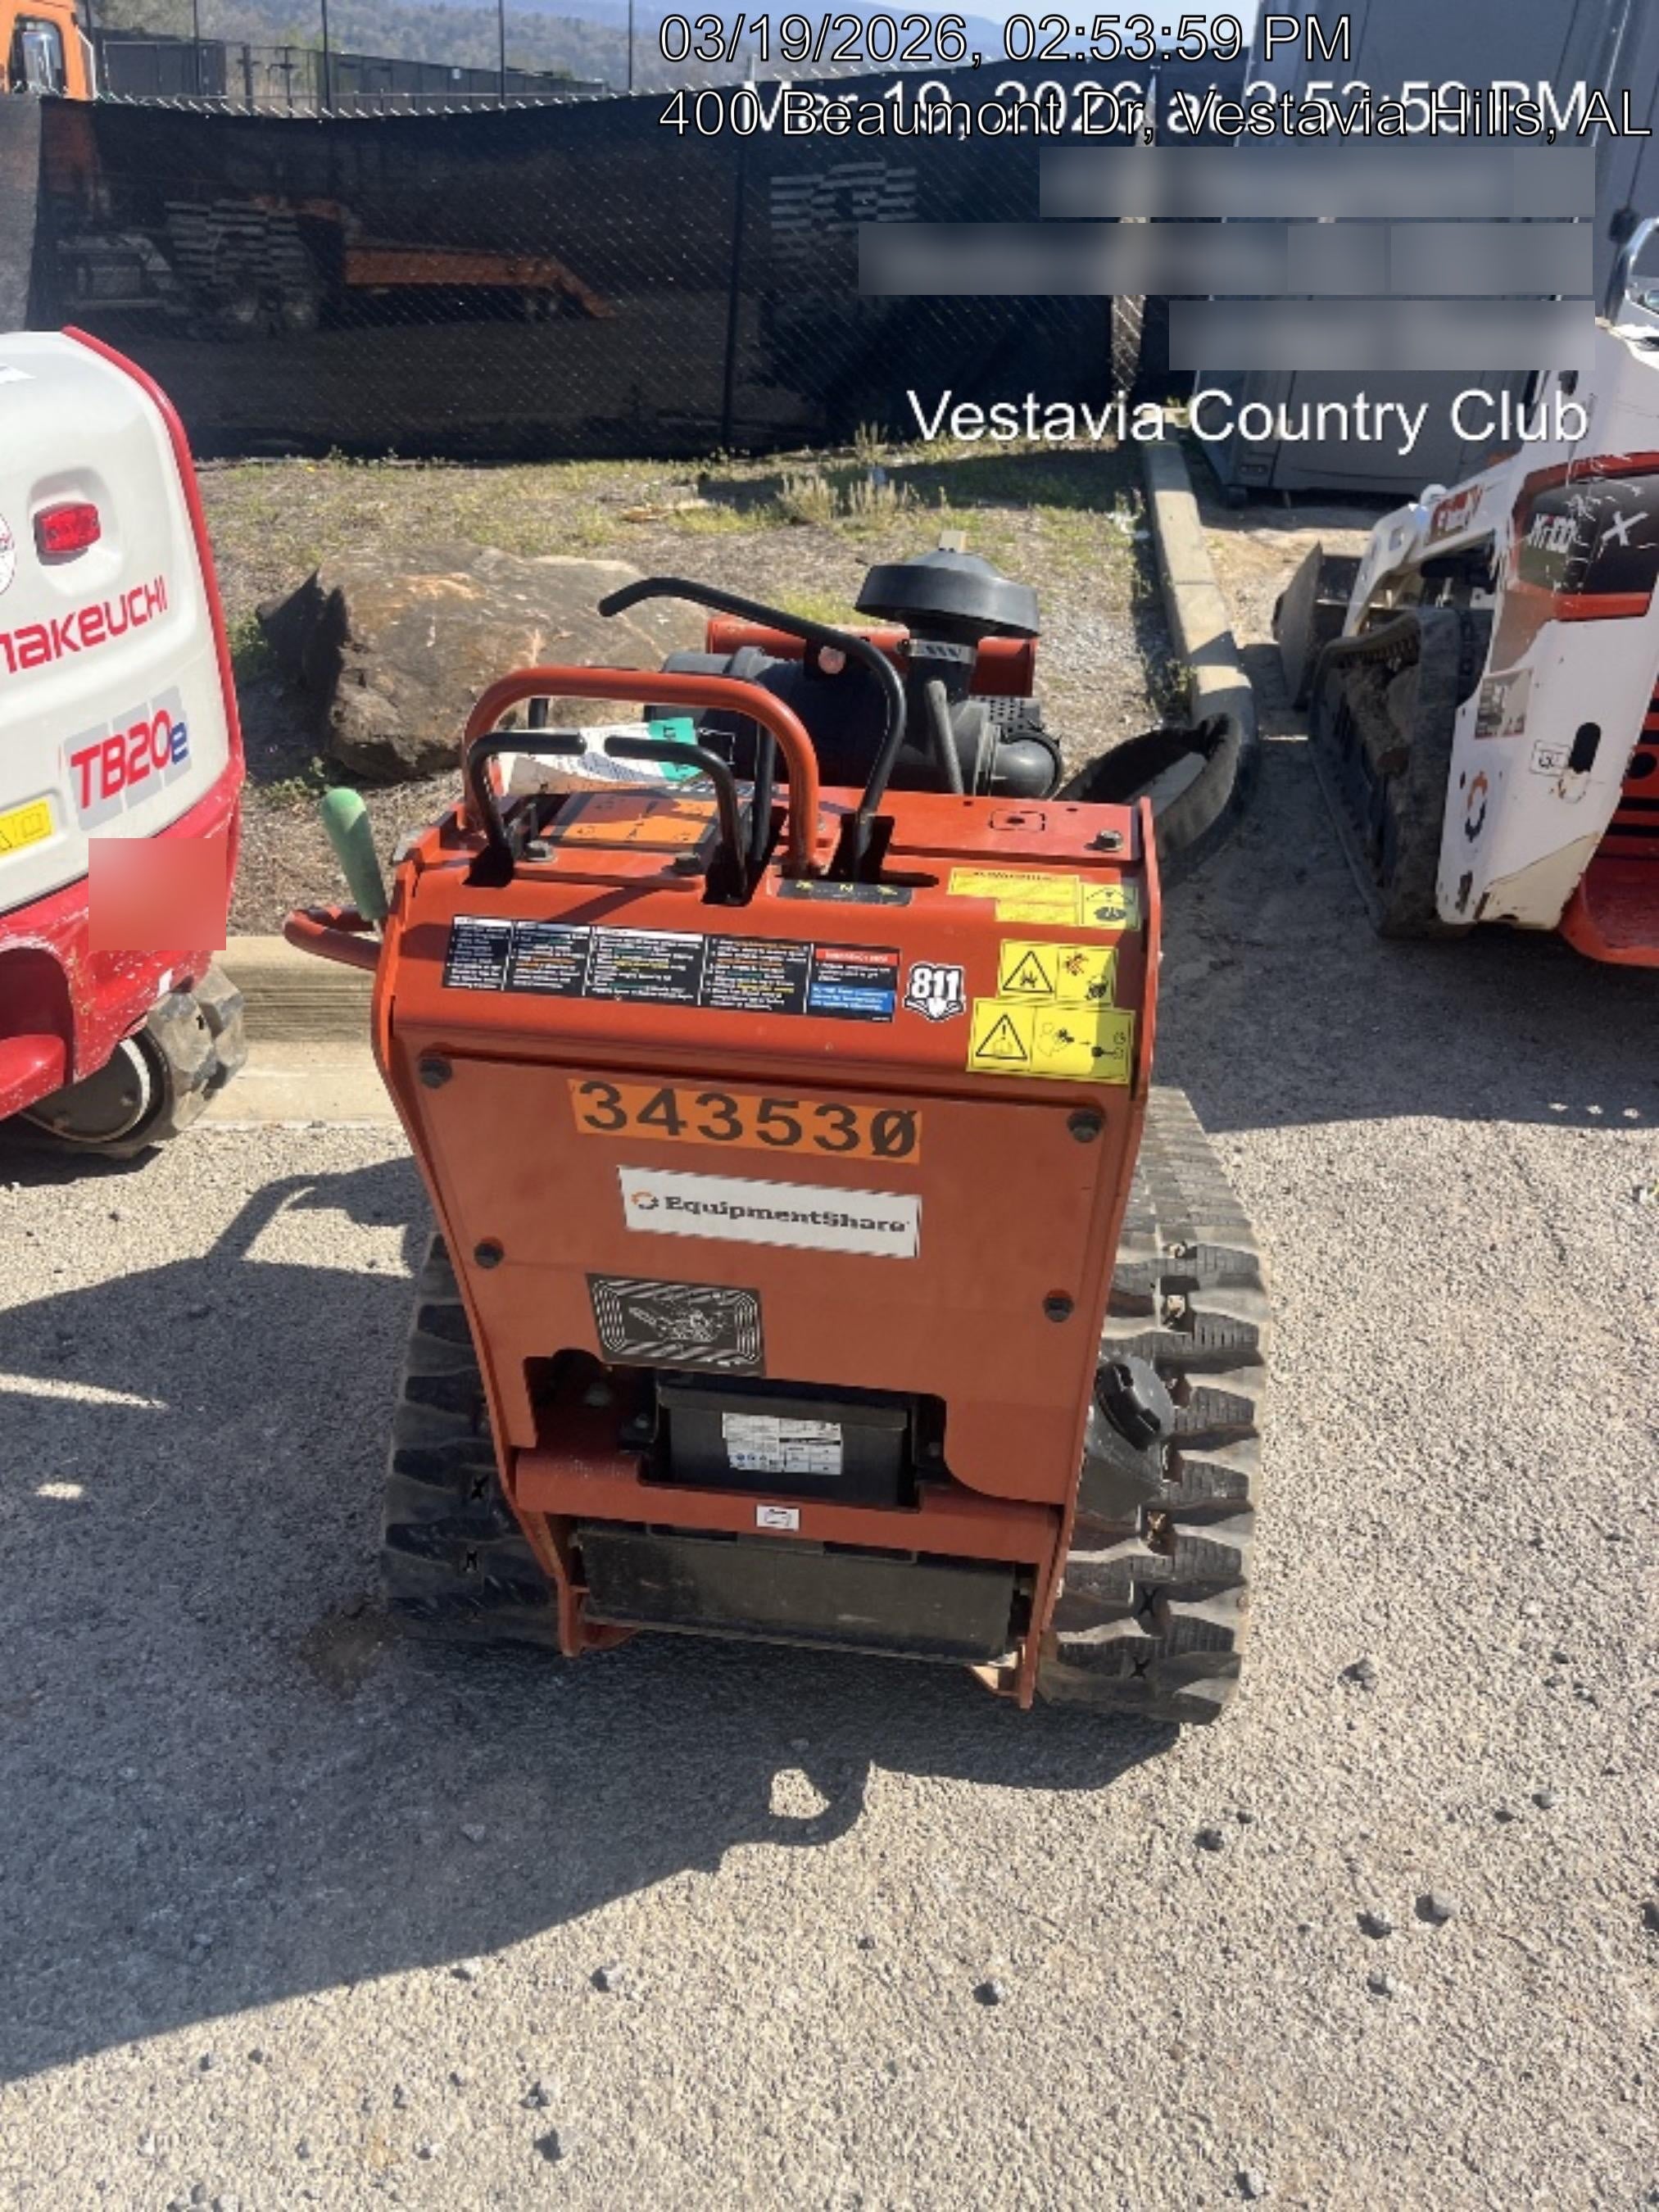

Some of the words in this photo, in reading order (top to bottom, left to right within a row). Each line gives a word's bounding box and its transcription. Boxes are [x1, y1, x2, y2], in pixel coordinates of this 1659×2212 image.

[70, 709, 190, 809] TB20e
[911, 968, 959, 1001] 811
[664, 1195, 905, 1233] EquipmentShare
